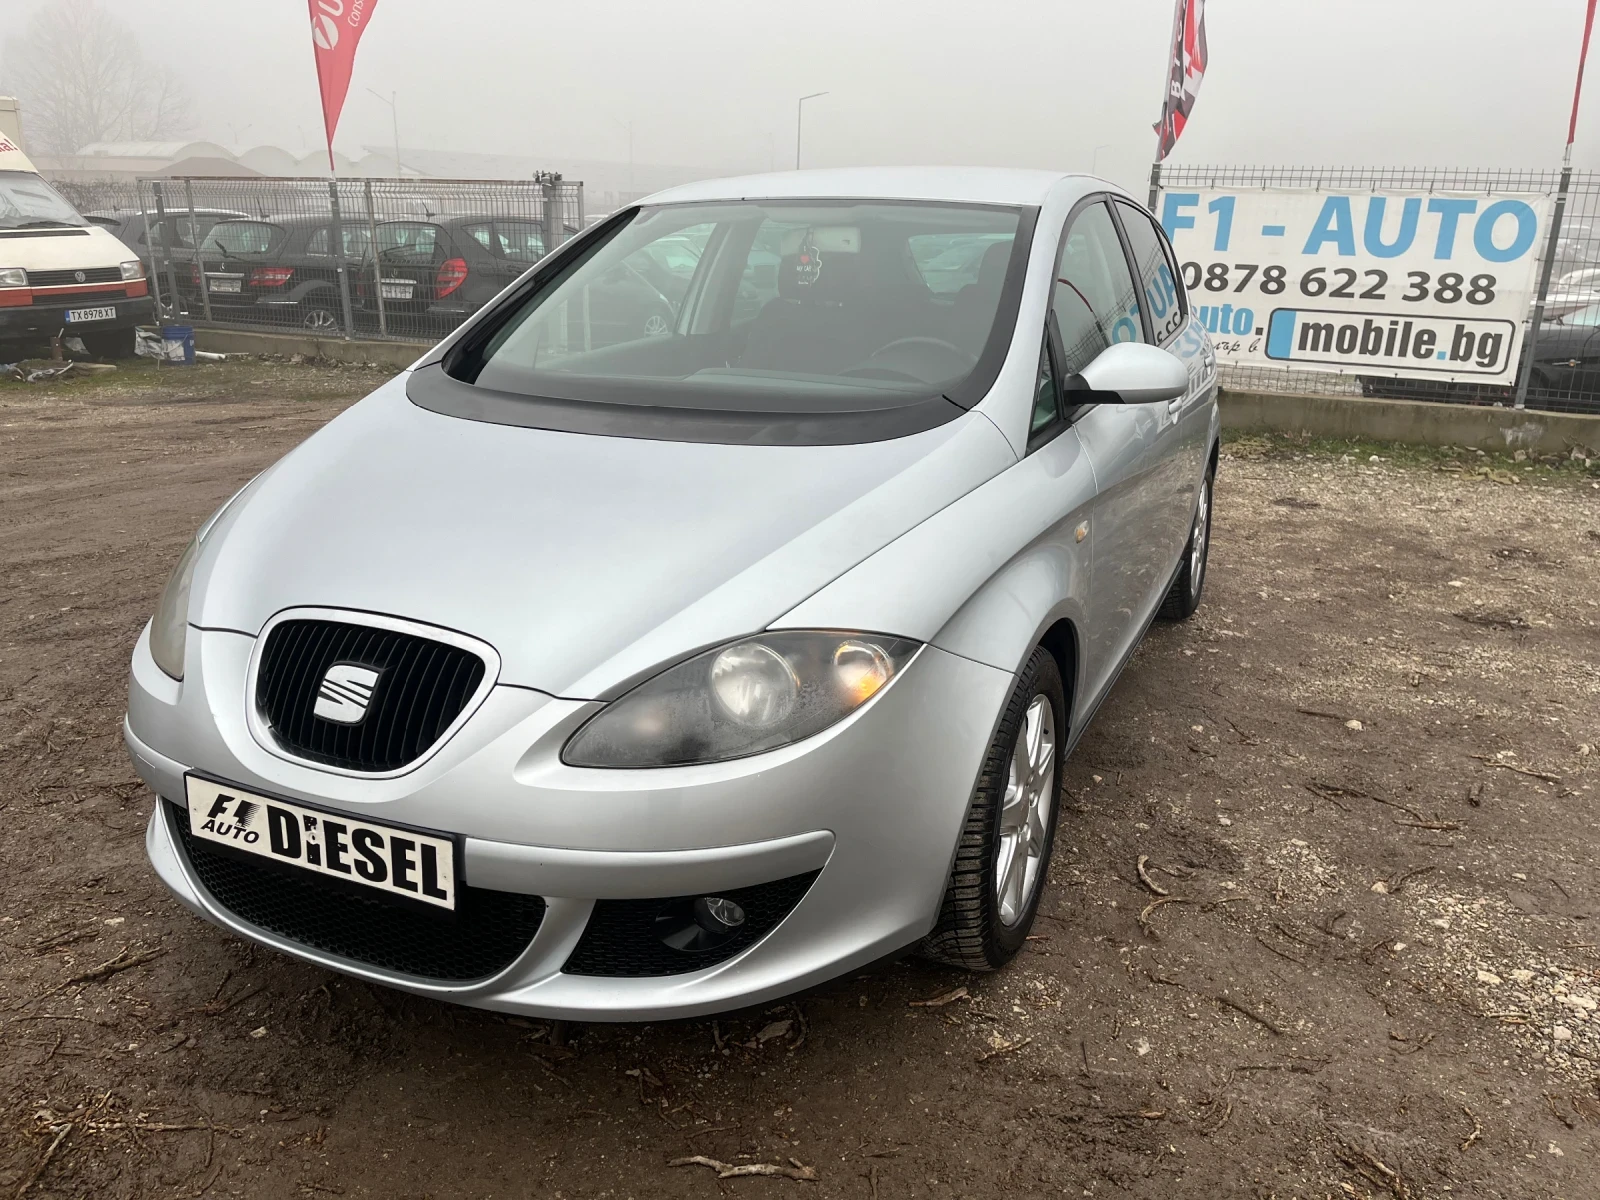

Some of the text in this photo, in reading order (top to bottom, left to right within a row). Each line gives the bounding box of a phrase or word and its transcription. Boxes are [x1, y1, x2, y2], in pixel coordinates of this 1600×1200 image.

[1161, 193, 1236, 252] F1
[1301, 195, 1537, 264] AUTO
[1180, 261, 1497, 306] 0878 622 388
[83, 309, 104, 320] 8978
[1192, 303, 1264, 336] uto.
[1298, 318, 1503, 368] mobile.bg
[200, 818, 260, 844] AUTO
